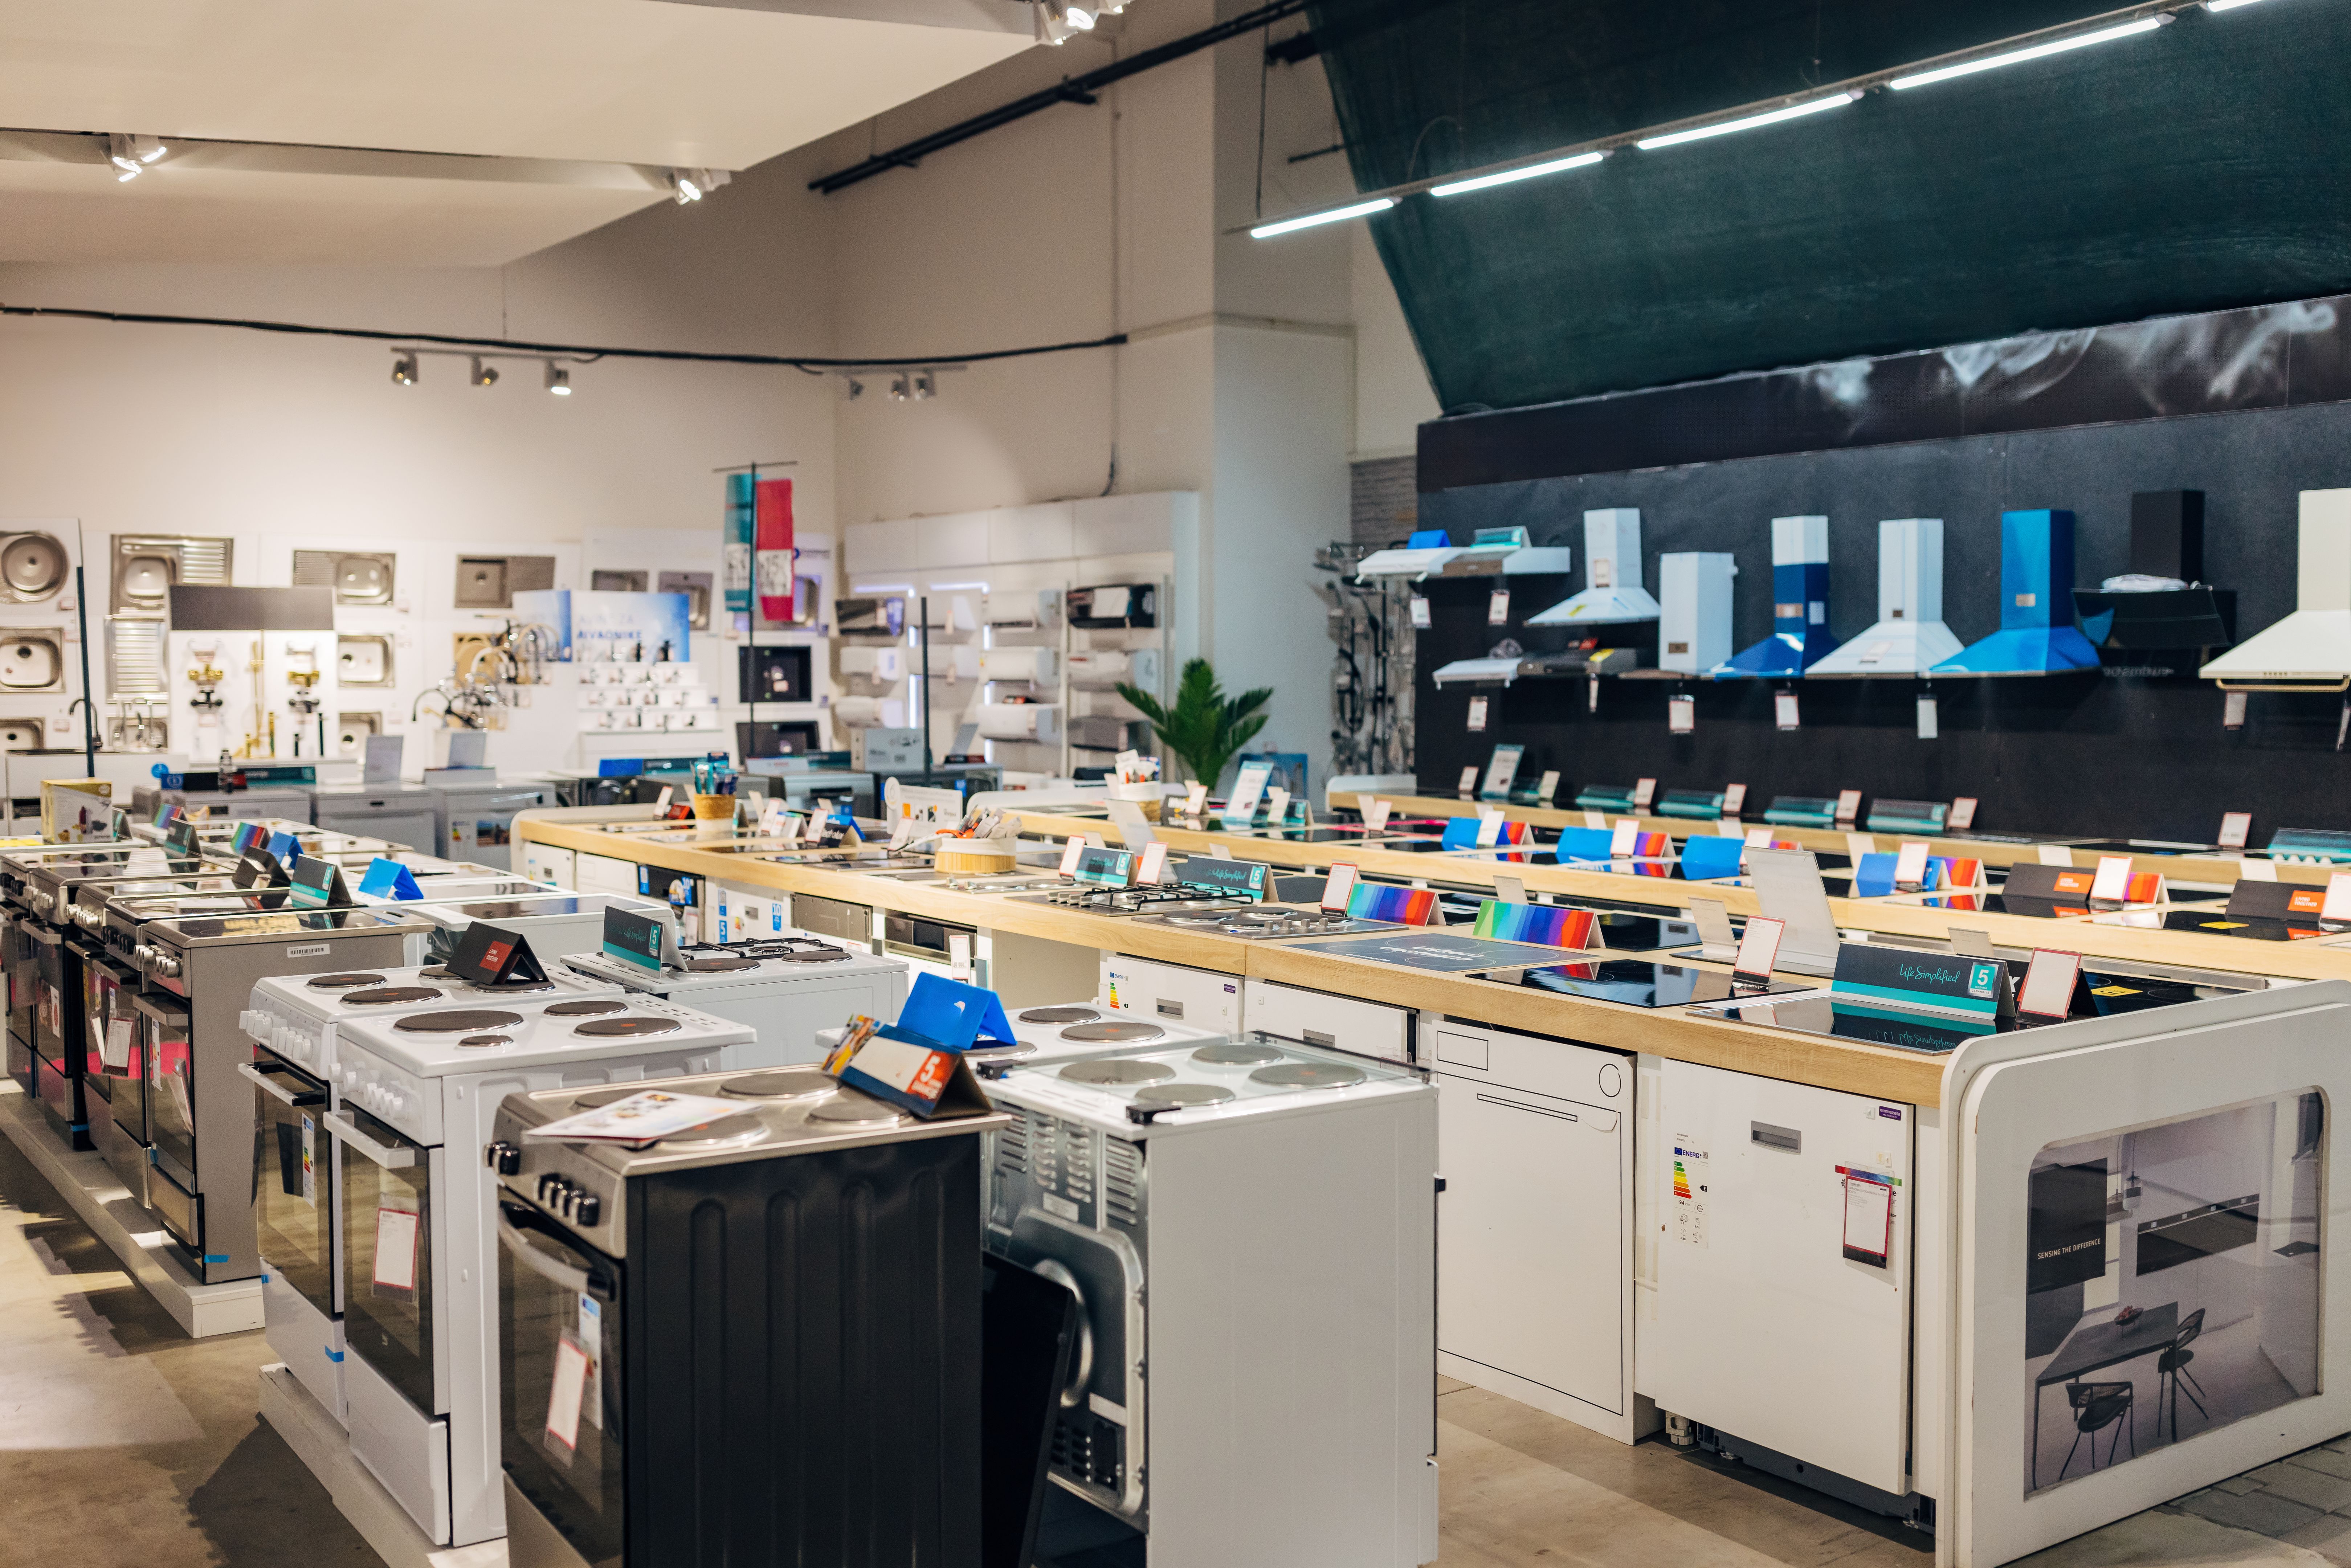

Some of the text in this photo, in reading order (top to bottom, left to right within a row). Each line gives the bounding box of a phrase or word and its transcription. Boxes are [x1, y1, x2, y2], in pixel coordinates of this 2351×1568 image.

[1120, 857, 1126, 870] 5
[1253, 870, 1261, 881] 5
[773, 904, 781, 916] 10
[720, 921, 726, 936] 5
[652, 930, 657, 945] 5
[1412, 946, 1485, 957] Uskoro
[1900, 963, 1960, 984] Life Simplified
[1977, 969, 1989, 985] 5
[920, 1055, 941, 1083] 5
[1683, 1150, 1699, 1159] ENERG
[2037, 1249, 2061, 1259] SENSING
[2073, 1238, 2101, 1251] DIFFERENCE
